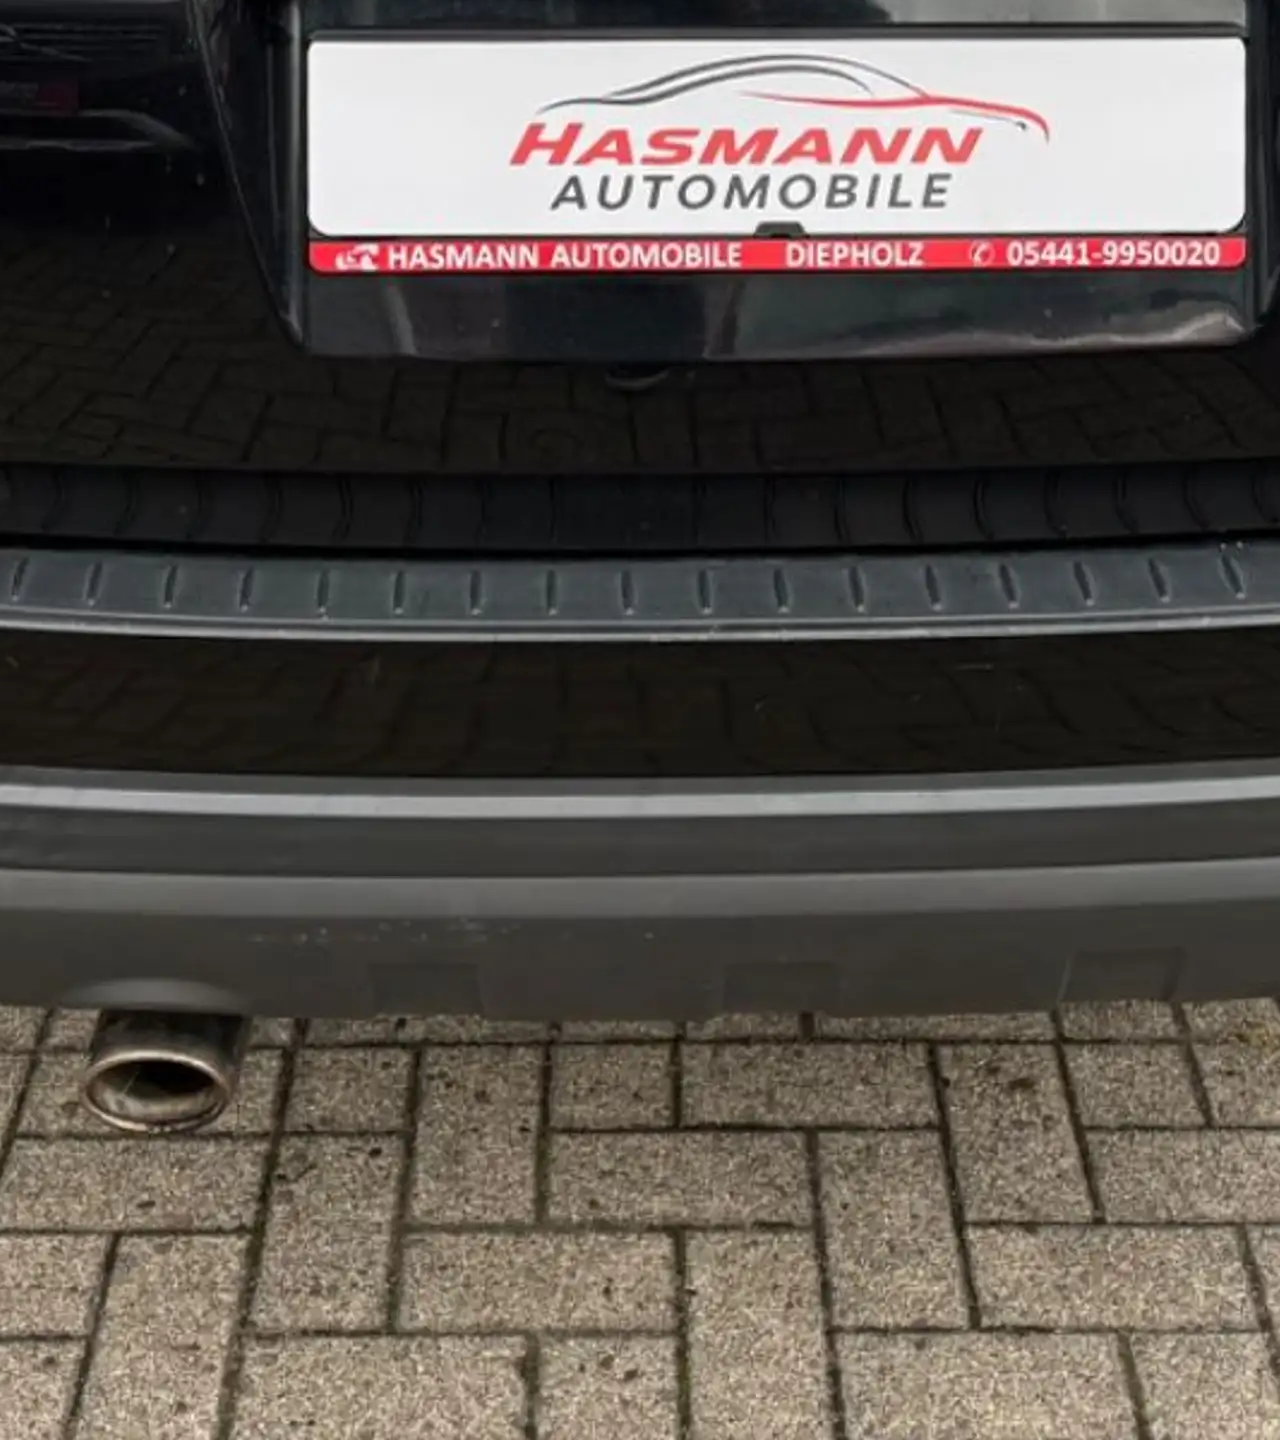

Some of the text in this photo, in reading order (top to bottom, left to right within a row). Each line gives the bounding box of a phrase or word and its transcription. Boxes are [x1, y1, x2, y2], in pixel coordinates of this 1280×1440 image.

[509, 122, 984, 166] HASMANN
[550, 172, 953, 211] AUTOMOBILE
[388, 239, 1221, 269] HASMANN AUTOMOBILE DIEPHOLZ 05441-9950020
